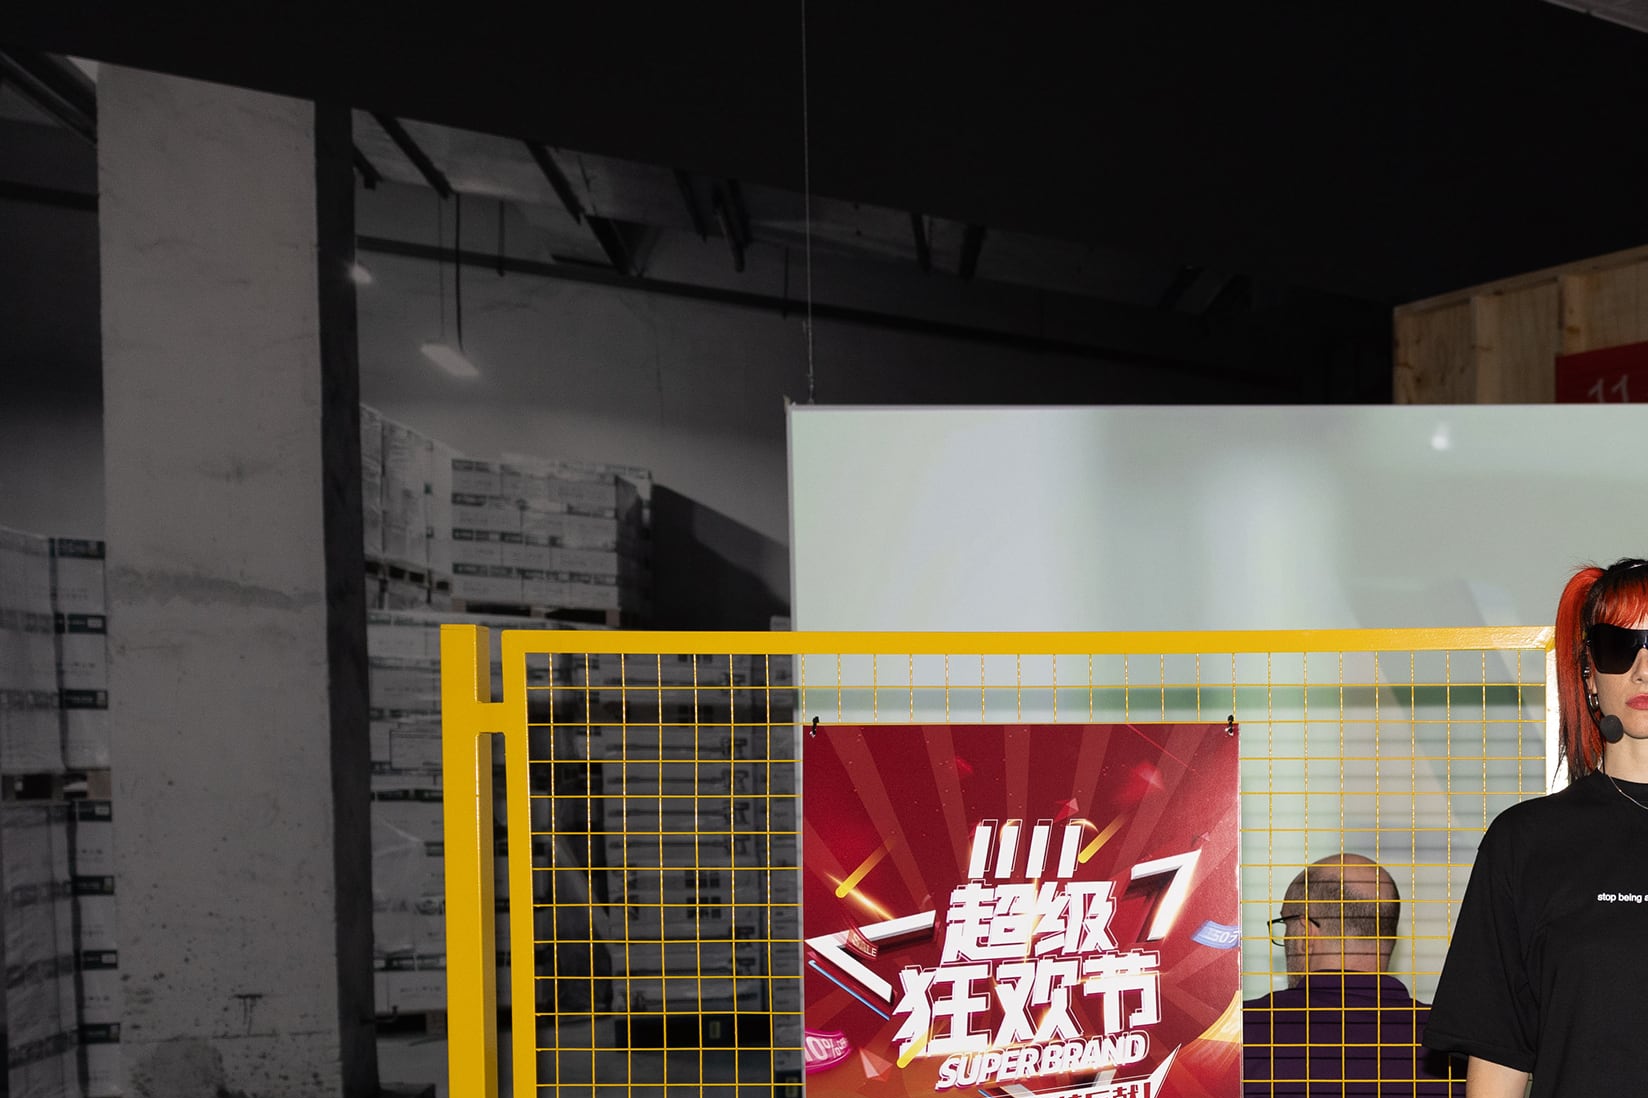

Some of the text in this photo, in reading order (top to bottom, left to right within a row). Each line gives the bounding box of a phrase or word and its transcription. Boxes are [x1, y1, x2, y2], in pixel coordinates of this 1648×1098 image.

[941, 879, 1118, 963] 超级
[1597, 892, 1617, 903] stop
[1618, 892, 1642, 904] being
[892, 949, 1162, 1058] 狂欢节
